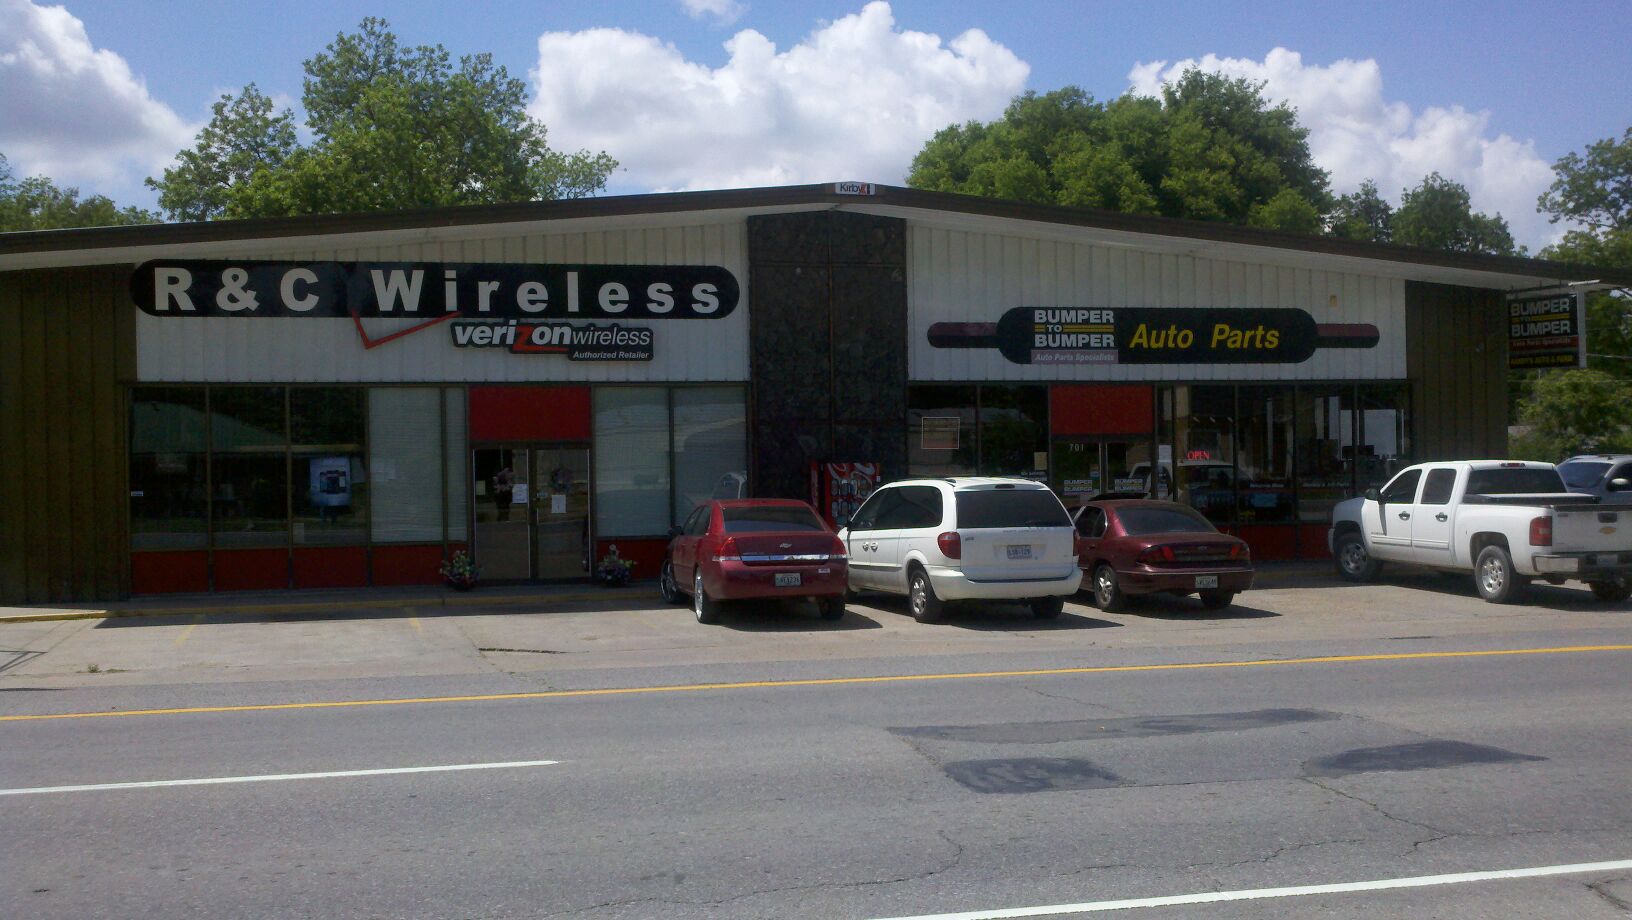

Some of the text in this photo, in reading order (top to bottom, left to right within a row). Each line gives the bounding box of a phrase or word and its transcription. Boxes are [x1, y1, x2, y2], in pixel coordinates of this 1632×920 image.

[154, 267, 720, 314] R & C Wireless
[1511, 298, 1570, 316] BUMPER
[1034, 309, 1115, 323] BUMPER
[1046, 324, 1063, 333] TO
[1511, 320, 1571, 337] BUMPER
[1034, 334, 1115, 348] BUMPER
[1129, 323, 1280, 349] Auto Parts
[573, 351, 650, 359] Authorized Retailer
[1069, 443, 1084, 451] 701
[1187, 451, 1211, 460] OPEN
